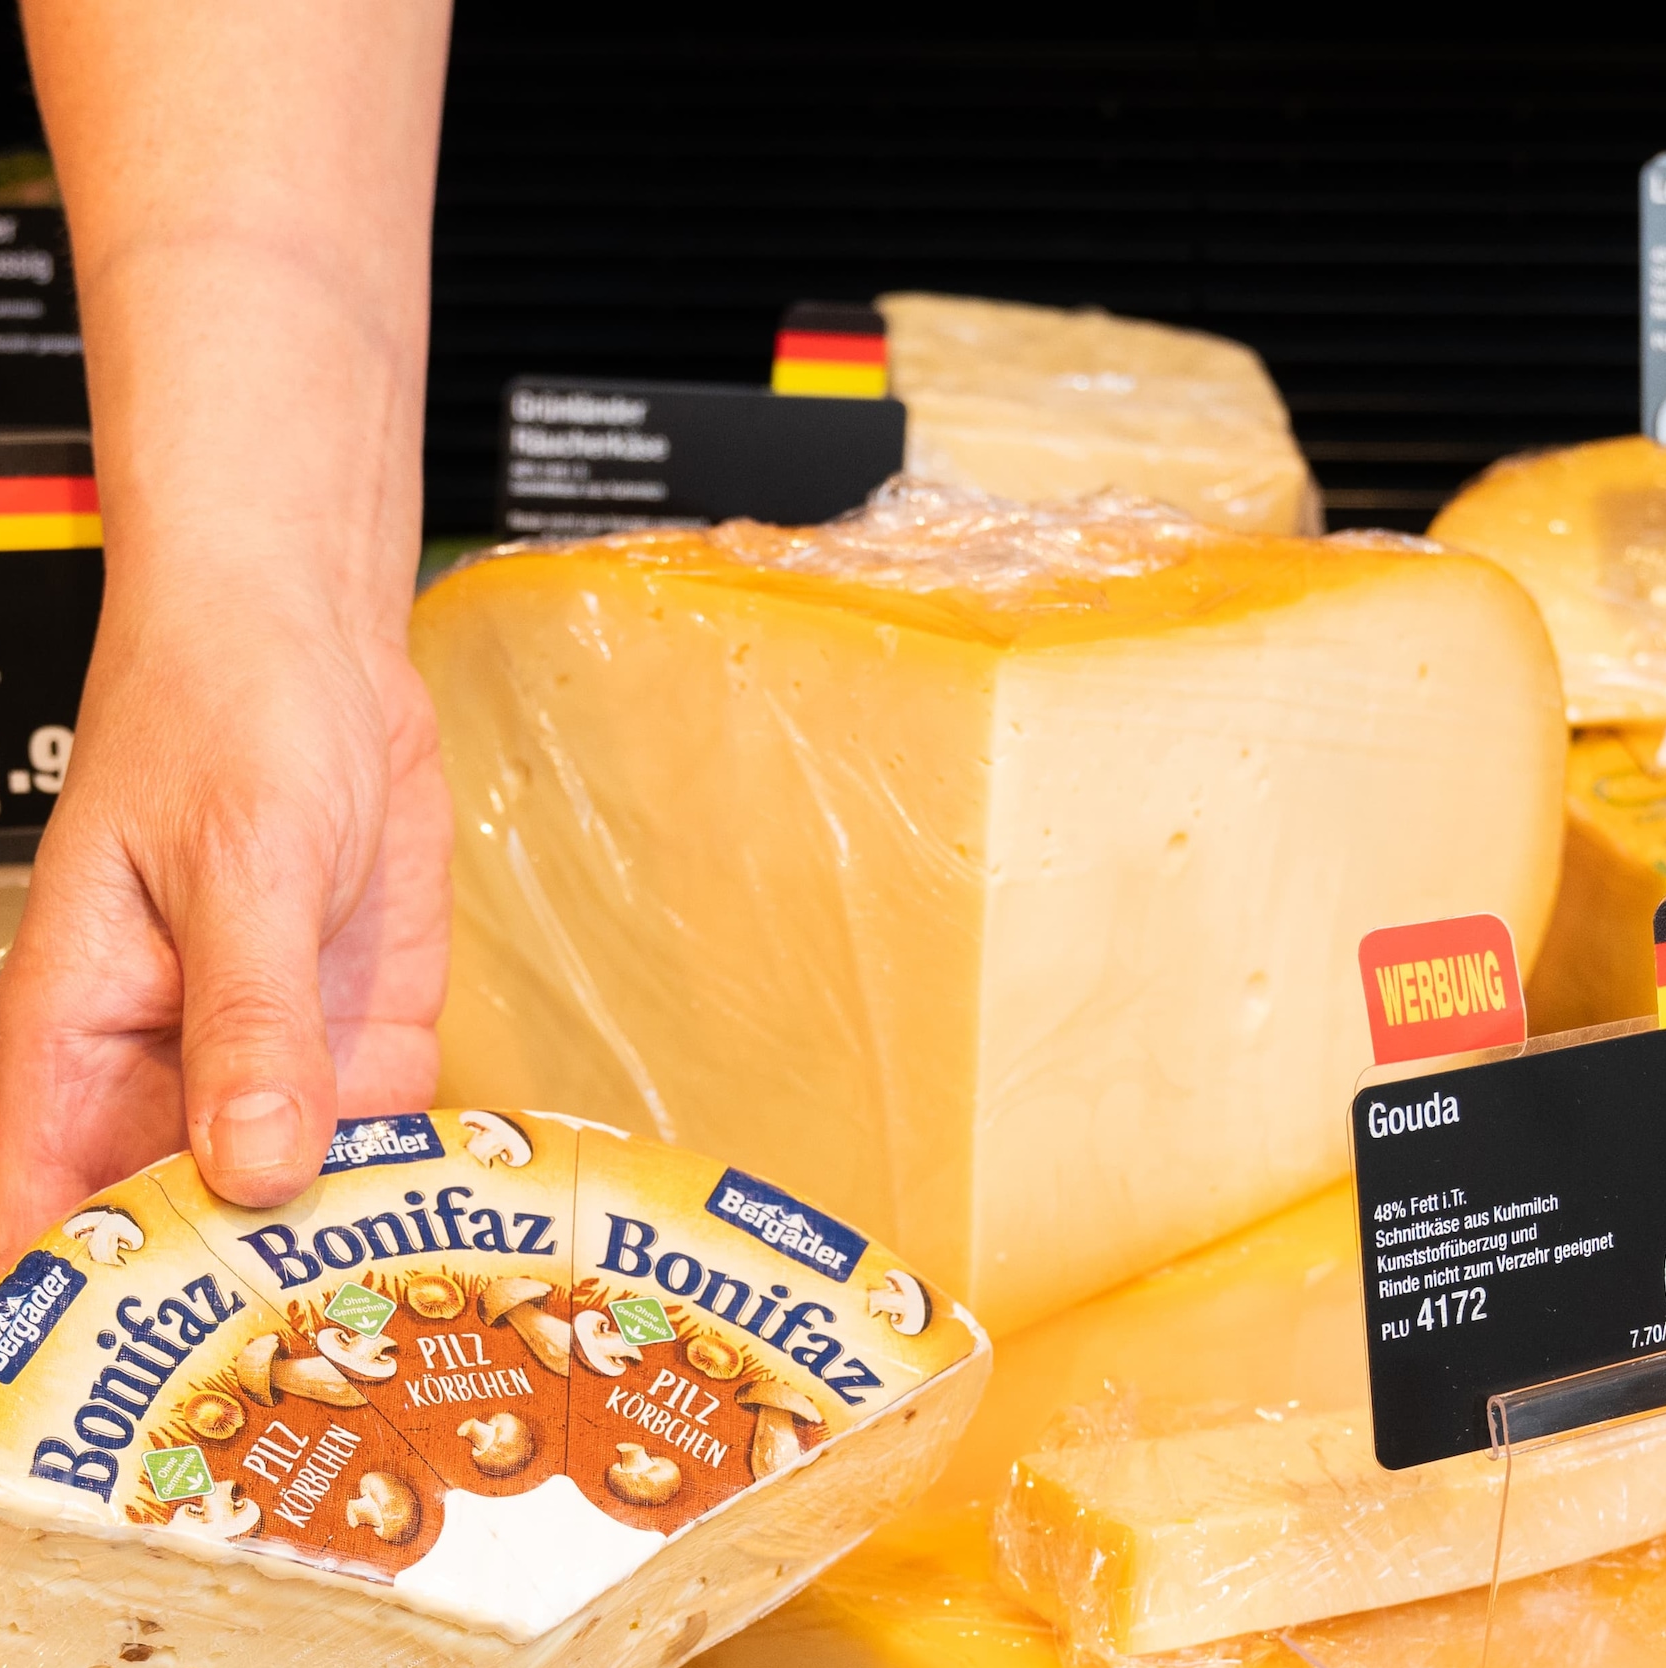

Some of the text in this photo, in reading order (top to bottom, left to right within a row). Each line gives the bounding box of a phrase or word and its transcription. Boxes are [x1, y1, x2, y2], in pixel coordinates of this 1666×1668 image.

[1375, 950, 1506, 1026] WERBUNG
[1369, 1092, 1459, 1138] Gouda
[238, 1184, 558, 1289] Bonifaz
[718, 1187, 847, 1271] Bergader
[1374, 1201, 1406, 1222] 48%
[1411, 1194, 1439, 1215] Fett
[1376, 1195, 1558, 1248] Schnittkäse aus Kuhmilch
[1378, 1223, 1537, 1273] Kunststoffüberzug und
[1379, 1232, 1614, 1298] Rinde nicht zum Verzehr geeignet
[596, 1212, 884, 1407] Bonifaz
[1417, 1287, 1487, 1331] 4172
[417, 1333, 489, 1370] PILZ
[29, 1273, 247, 1503] Bonifaz
[405, 1367, 532, 1407] KÖRBCHEN
[646, 1368, 722, 1427] PILZ
[243, 1420, 310, 1486] PILZ
[605, 1385, 727, 1469] KÖRBCHEN
[273, 1425, 362, 1529] KÖRBCHEN
